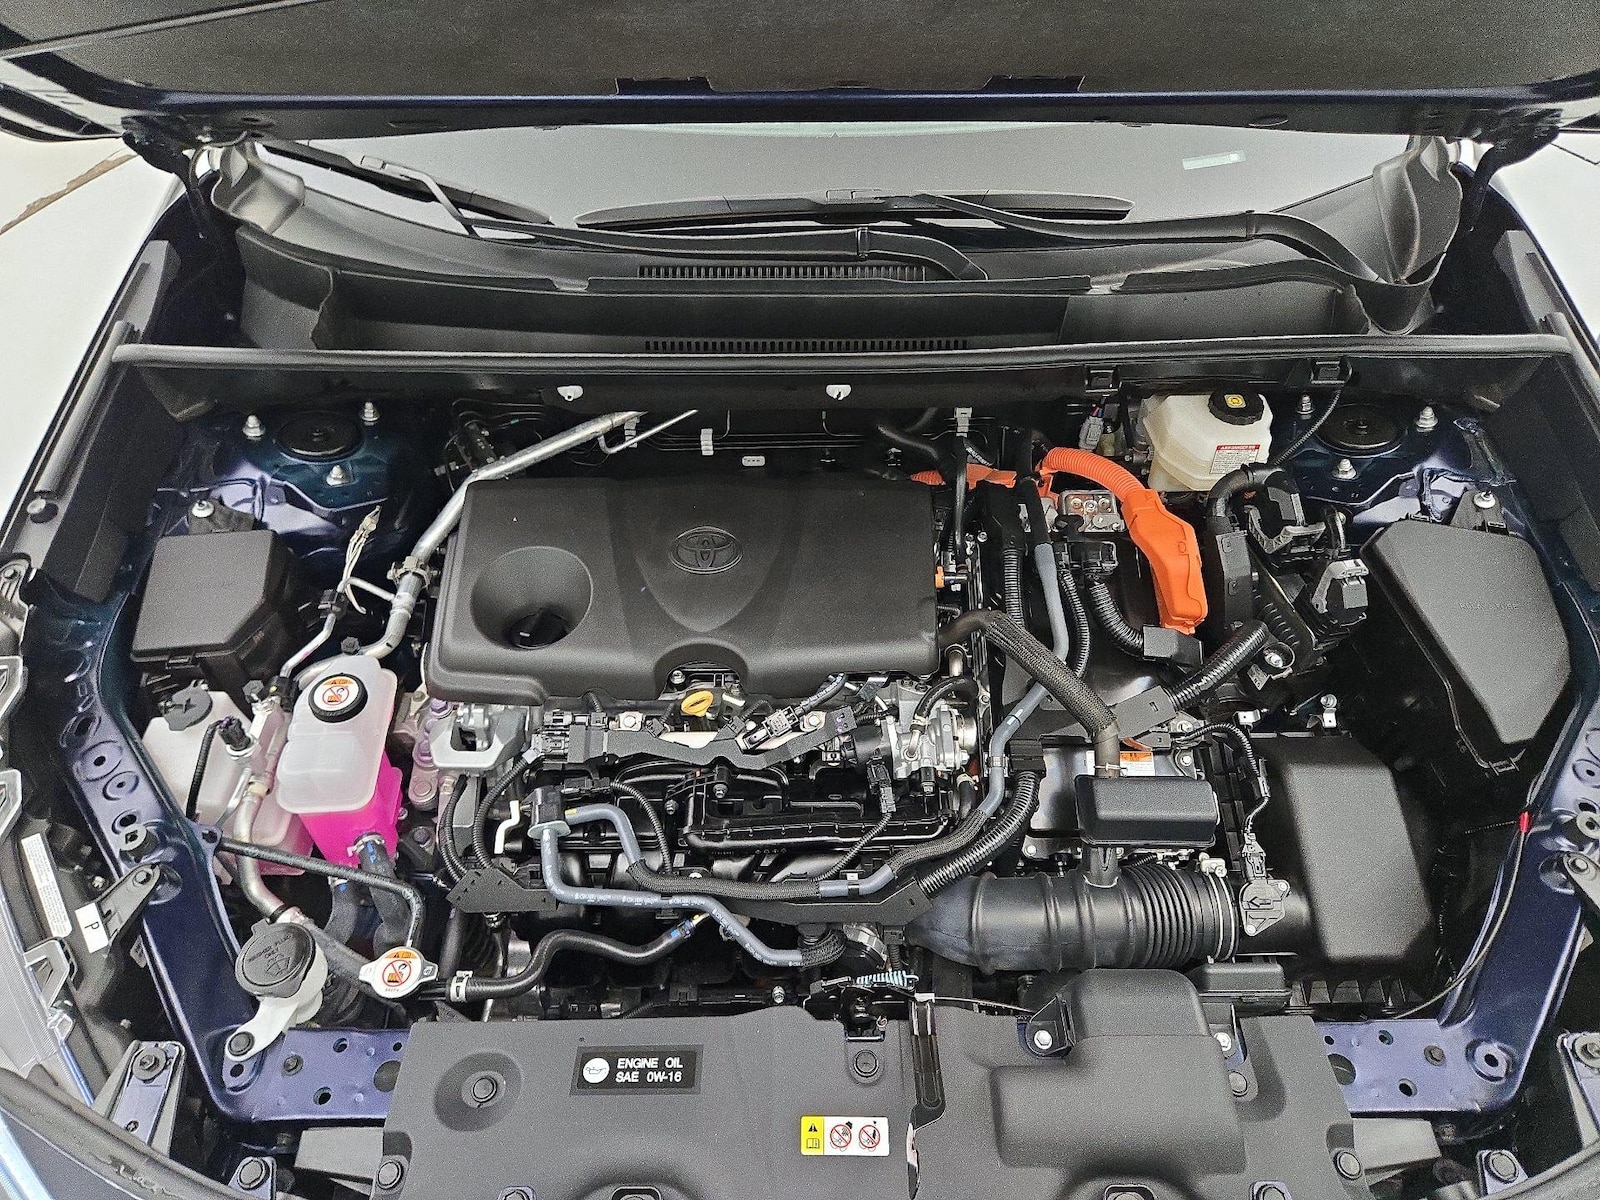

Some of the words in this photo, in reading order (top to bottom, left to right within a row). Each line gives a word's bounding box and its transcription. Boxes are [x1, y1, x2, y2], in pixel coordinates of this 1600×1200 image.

[84, 921, 100, 930] P
[617, 1058, 659, 1069] ENGINE
[665, 1057, 683, 1068] OIL
[615, 1071, 639, 1083] SAE
[646, 1071, 682, 1083] 0W-16
